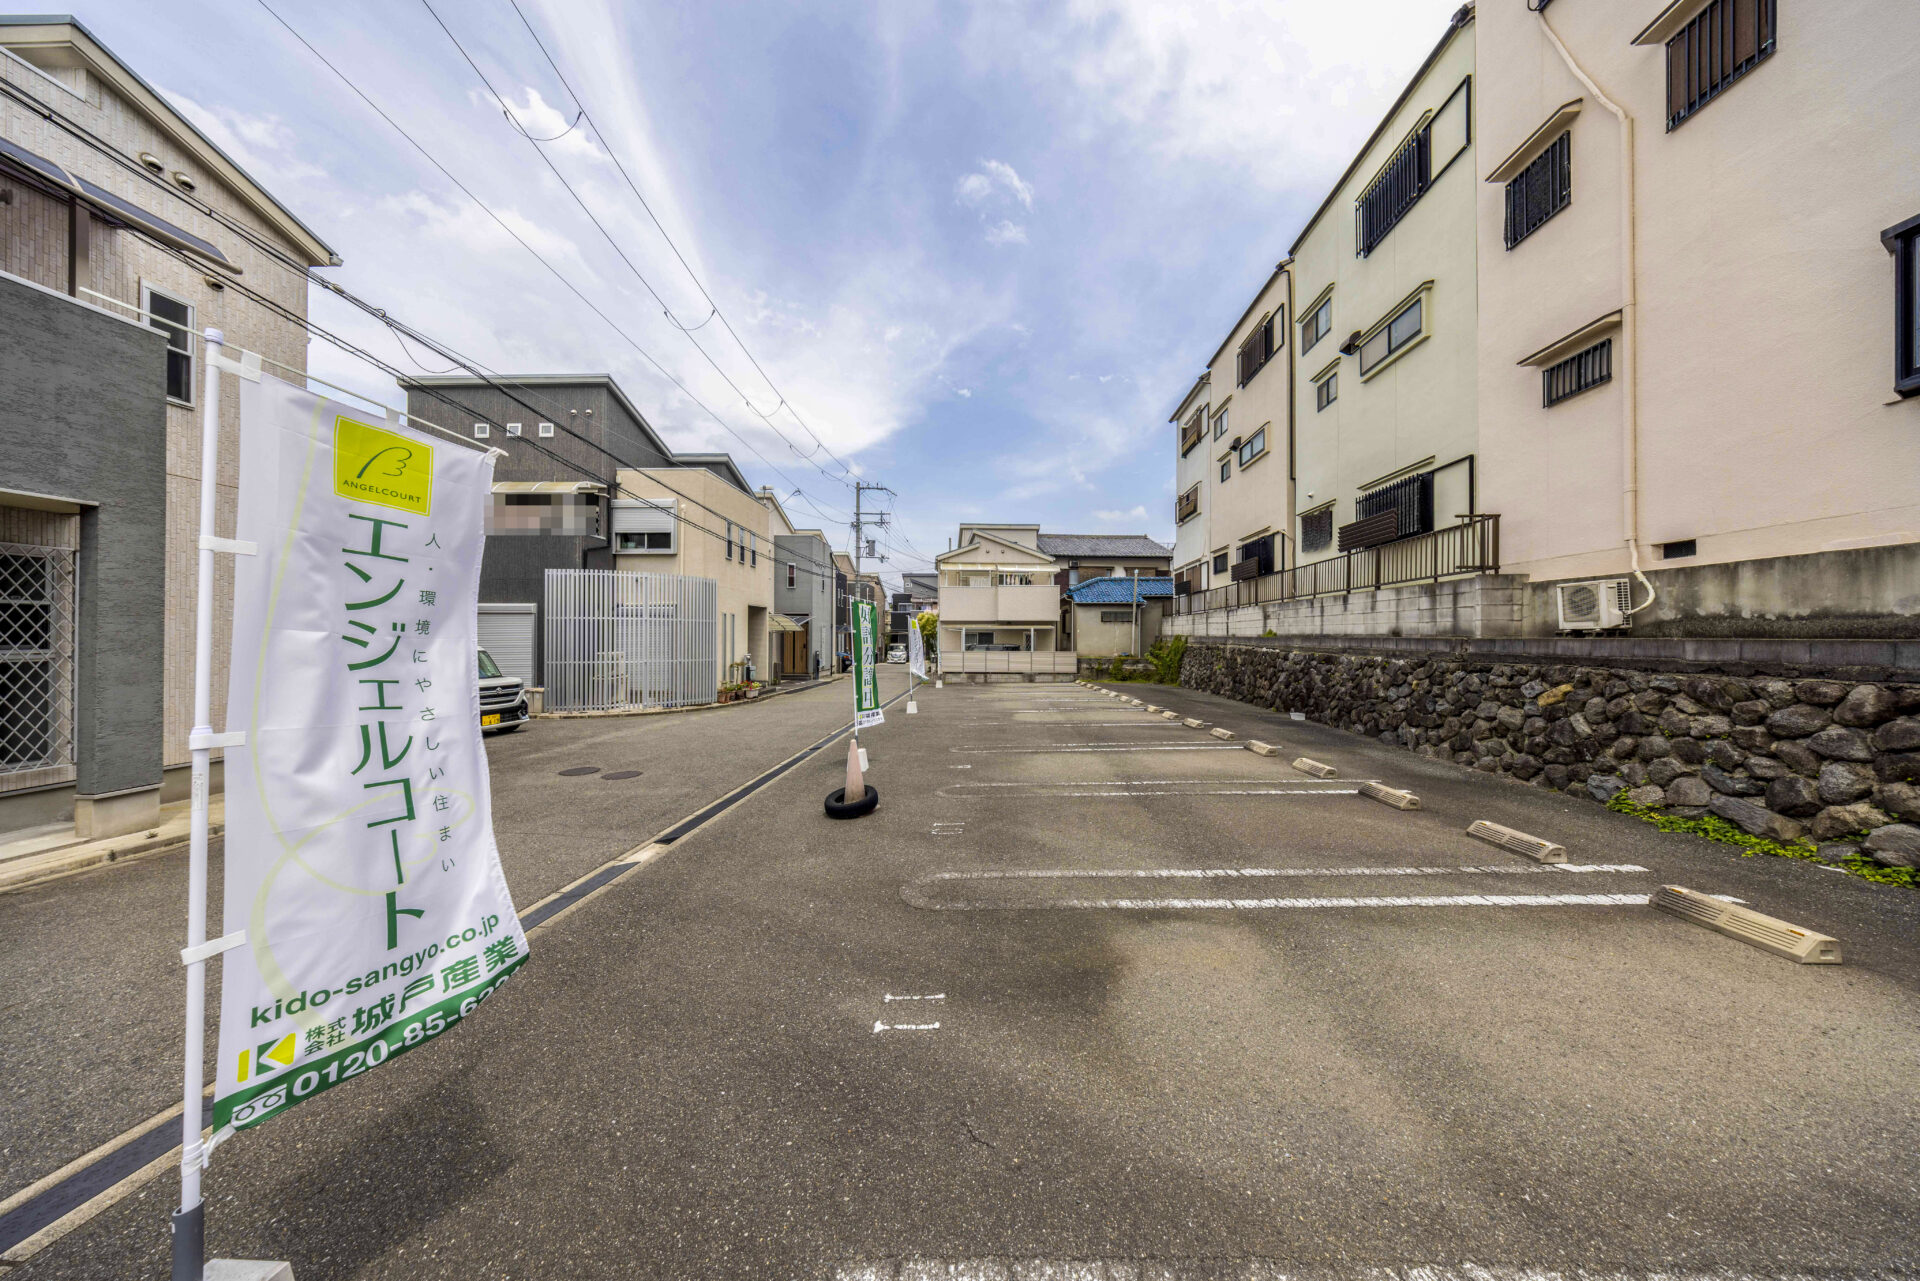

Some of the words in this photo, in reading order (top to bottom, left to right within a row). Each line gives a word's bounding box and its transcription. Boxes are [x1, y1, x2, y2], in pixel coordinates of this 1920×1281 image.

[342, 478, 422, 504] ANGELCOURT
[341, 513, 425, 952] エンジェルコート
[412, 533, 456, 873] 人・環境にやさしい住まい
[250, 914, 500, 1029] kido-sangyo.co.jp
[350, 935, 519, 1037] 城戸産業
